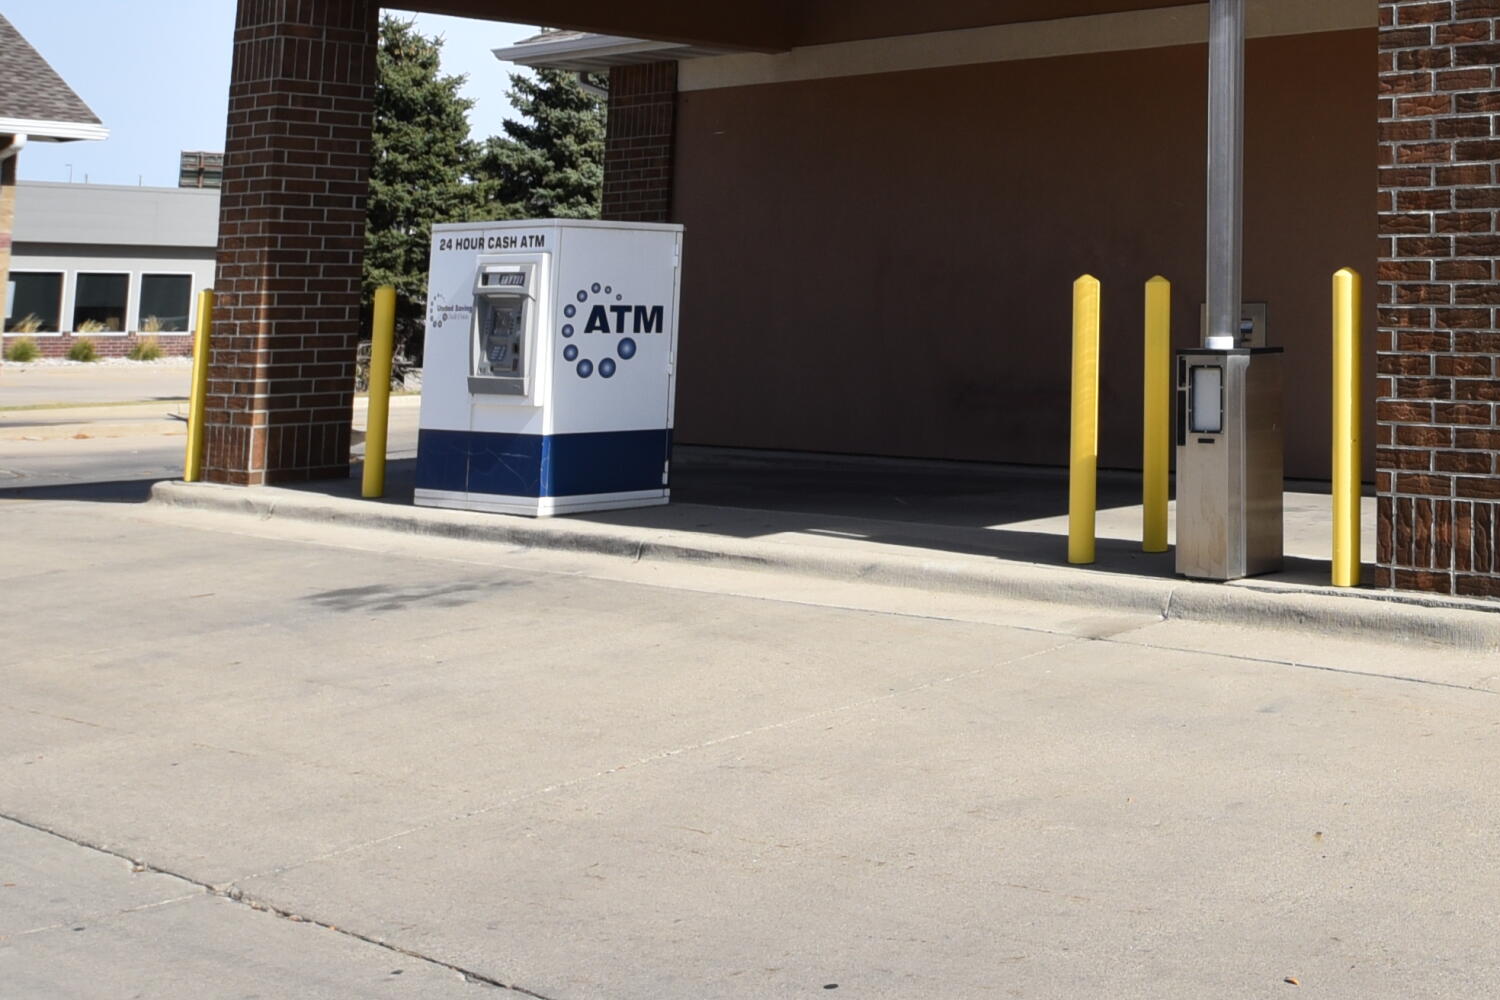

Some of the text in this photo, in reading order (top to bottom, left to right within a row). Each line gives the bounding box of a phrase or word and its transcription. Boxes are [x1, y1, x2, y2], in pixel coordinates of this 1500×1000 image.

[439, 234, 546, 251] 24 HOUR CASH ATM
[583, 304, 664, 334] ATM
